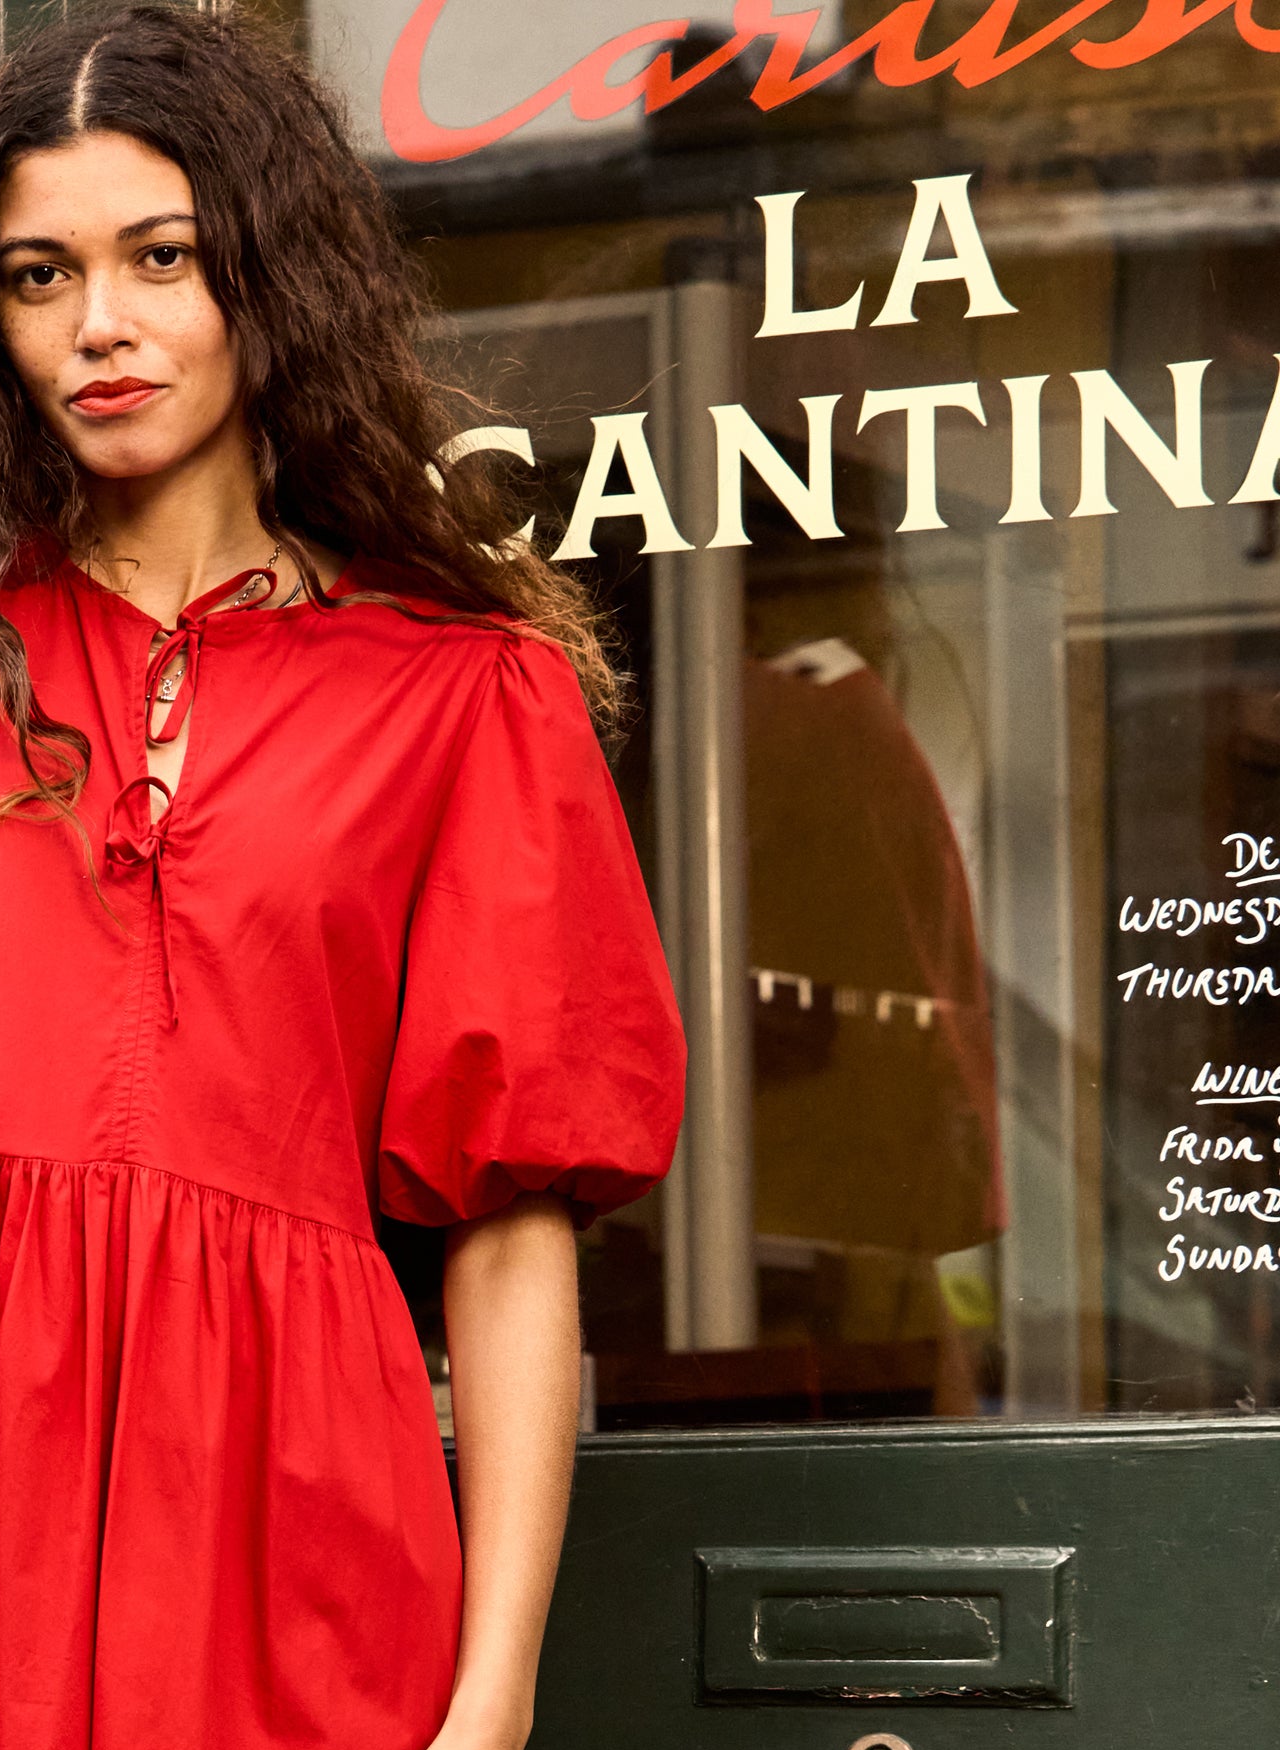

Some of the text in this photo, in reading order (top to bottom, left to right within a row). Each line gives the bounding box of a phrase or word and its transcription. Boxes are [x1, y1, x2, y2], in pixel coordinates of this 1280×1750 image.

[754, 173, 1020, 338] LA
[1117, 962, 1280, 1006] THURSDA
[1159, 1117, 1280, 1165] FRIDA
[1158, 1234, 1280, 1282] SUNDA
